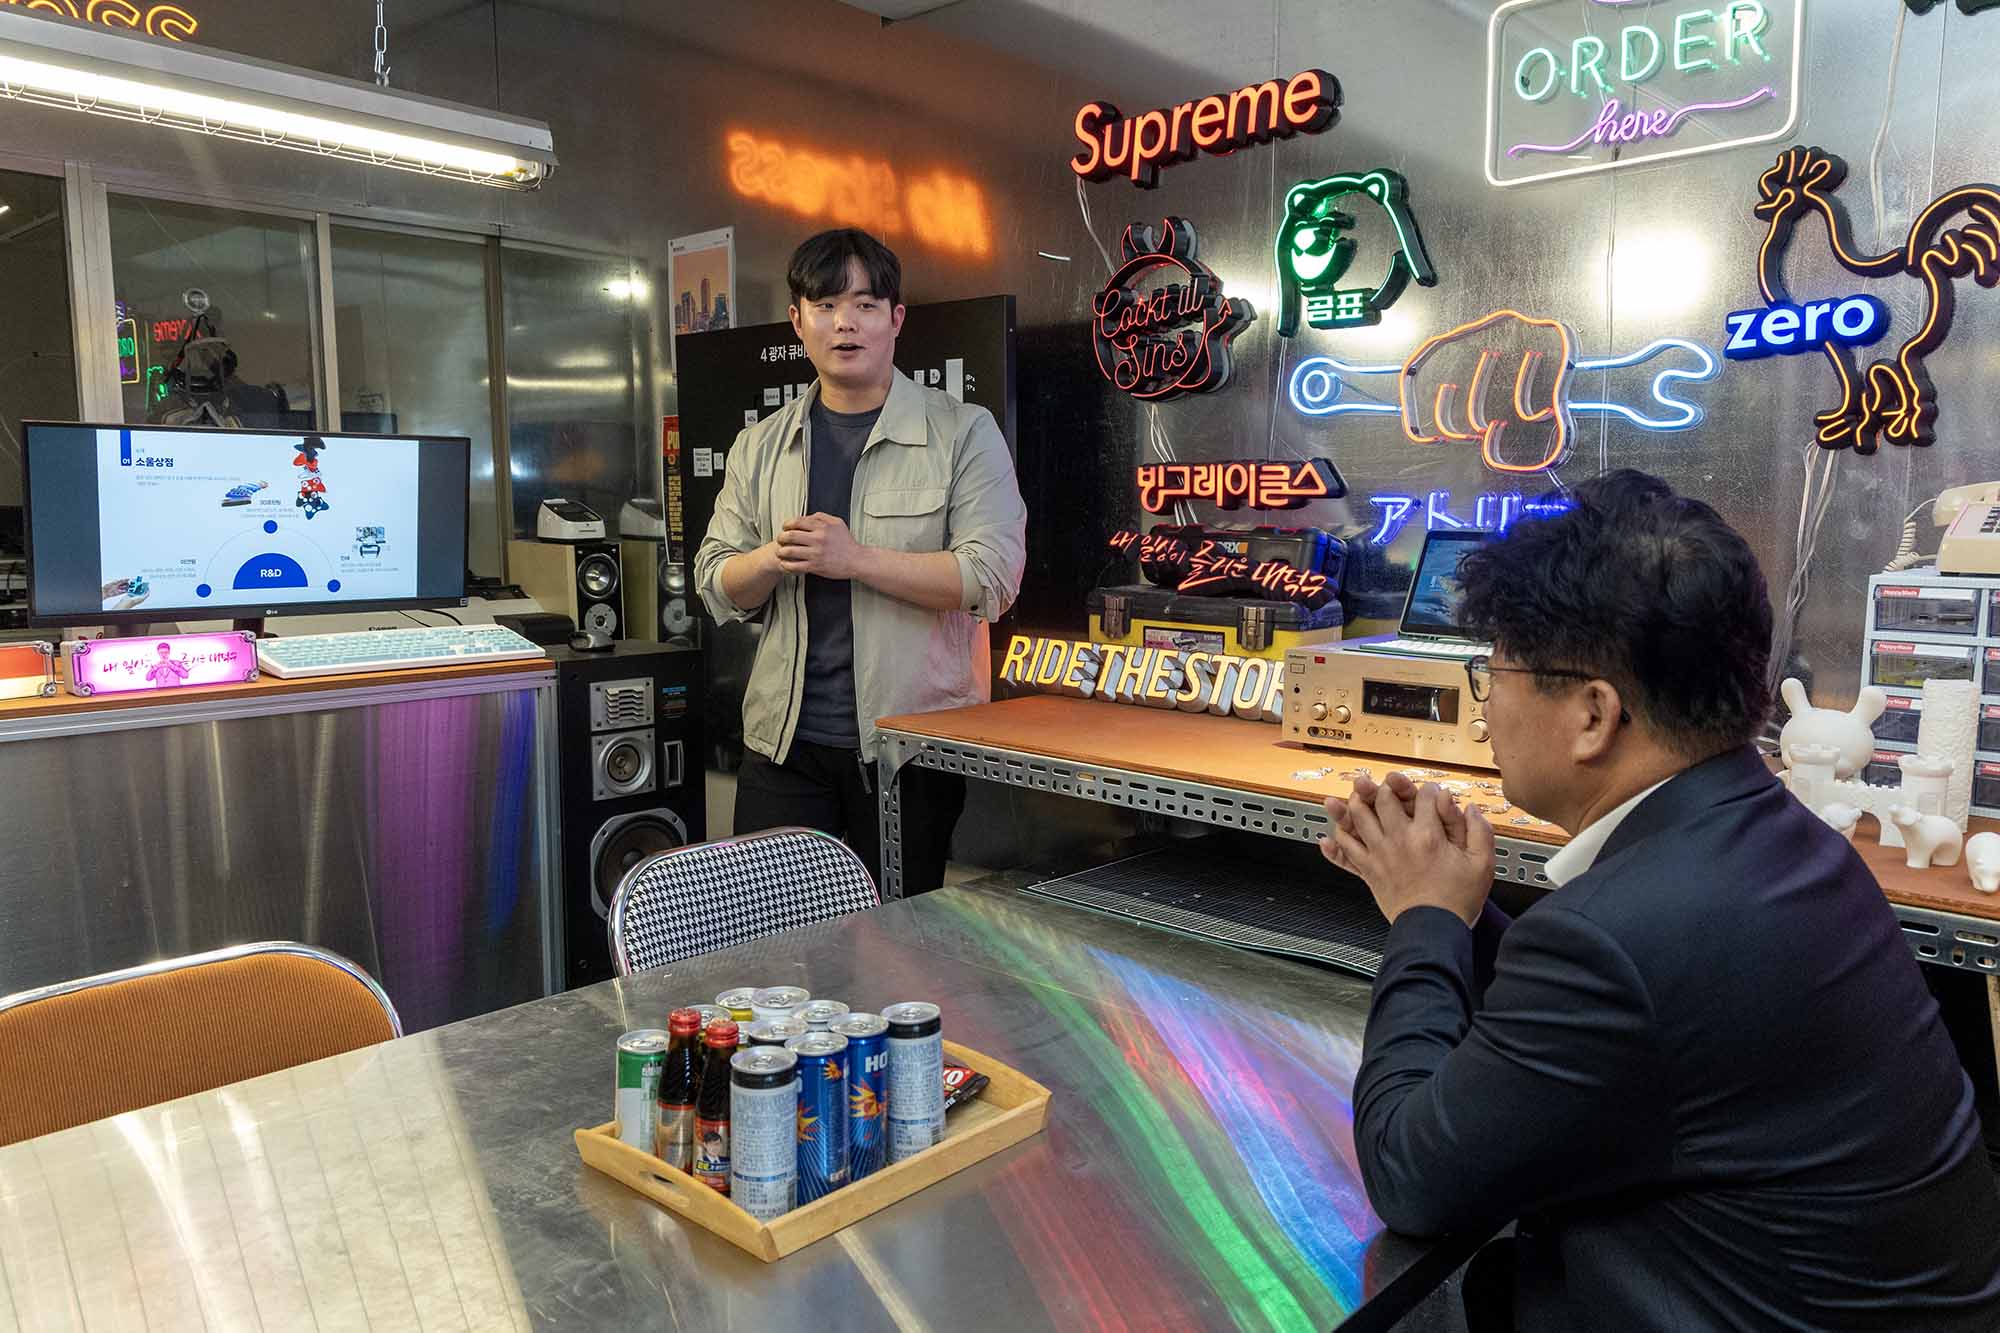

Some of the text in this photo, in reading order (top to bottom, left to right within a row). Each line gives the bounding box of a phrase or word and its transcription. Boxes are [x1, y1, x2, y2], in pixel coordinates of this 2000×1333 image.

[1515, 1, 1771, 100] ORDER
[1071, 71, 1321, 181] Supreme
[1093, 277, 1205, 338] Cocktil
[1307, 293, 1363, 321] 곰표
[1727, 299, 1875, 350] zero
[760, 344, 809, 362] 4 광자 큐비
[1111, 332, 1188, 390] Sins
[135, 457, 174, 468] 소울상점
[1137, 463, 1328, 513] 빙그레이글스
[1370, 491, 1568, 544] アトリ
[260, 568, 282, 578] R&D
[1109, 530, 1137, 553] 내
[1140, 535, 1187, 565] 일상이
[1251, 561, 1328, 598] 대덕구
